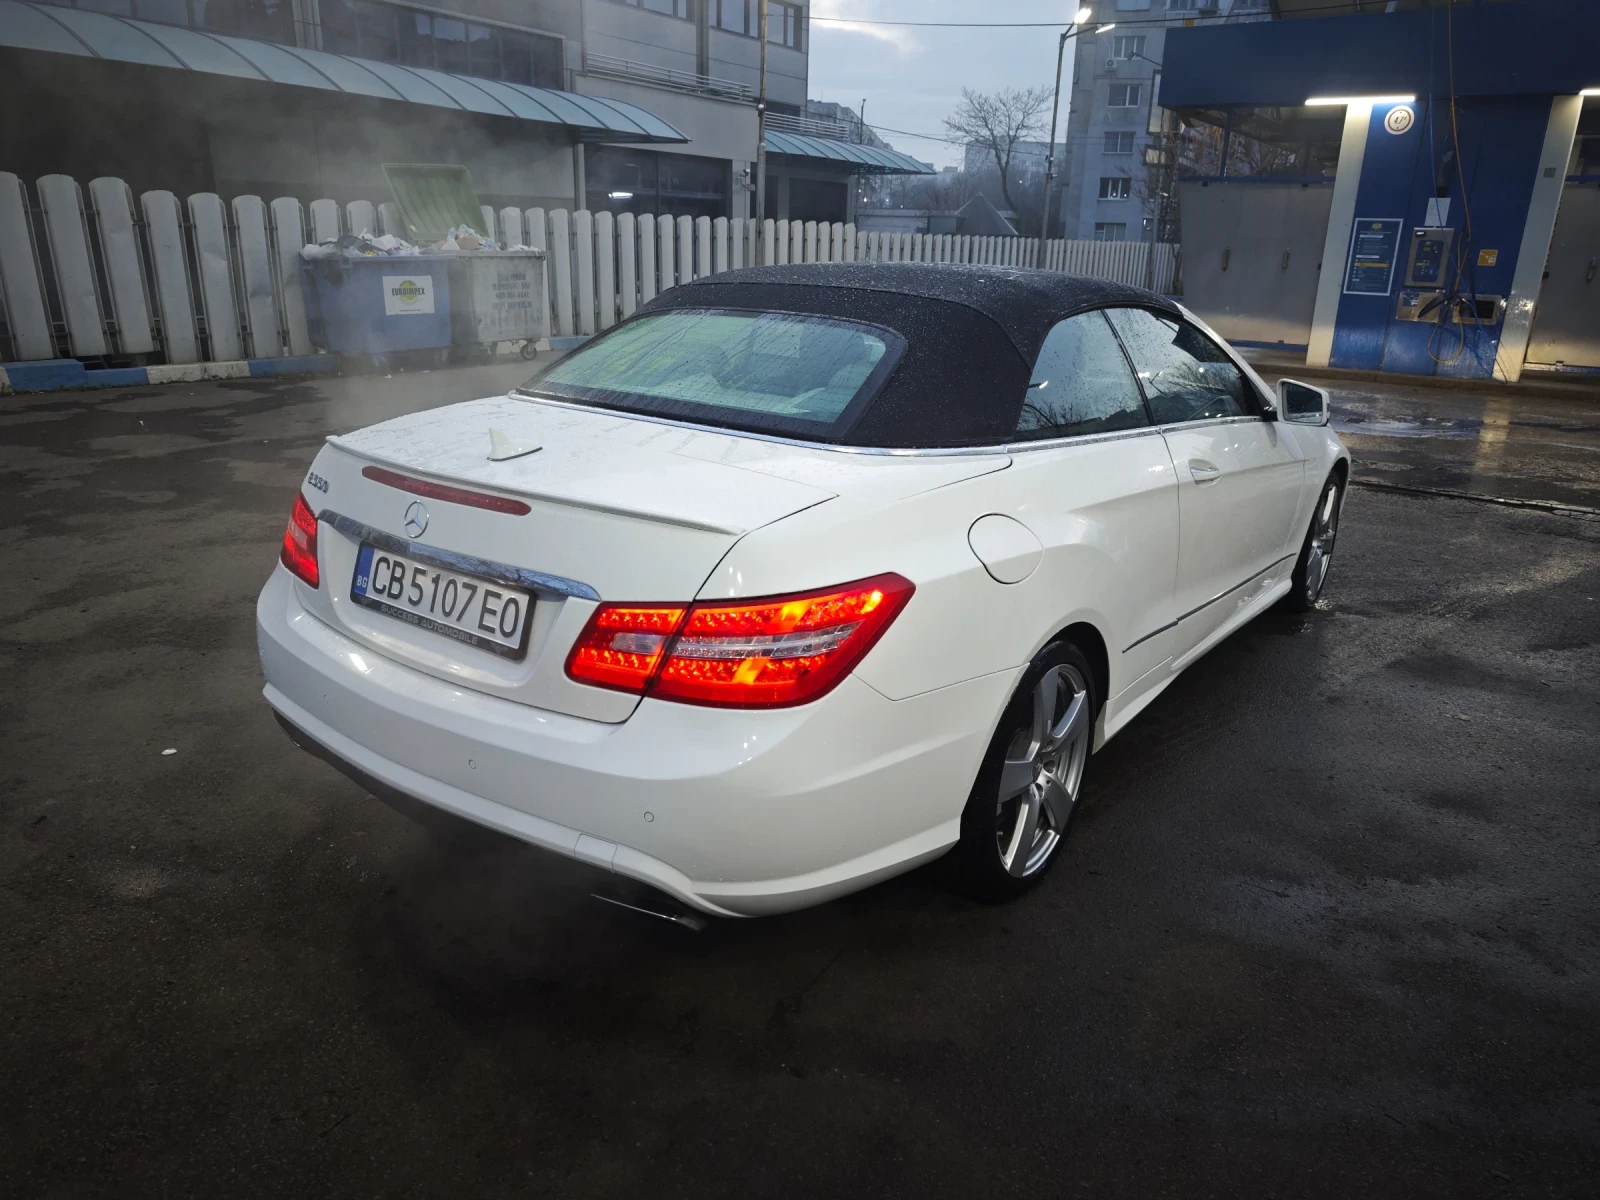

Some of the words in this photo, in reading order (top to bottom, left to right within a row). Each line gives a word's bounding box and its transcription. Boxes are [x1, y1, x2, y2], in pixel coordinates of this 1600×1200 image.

[391, 287, 426, 296] EUROIMPEX
[356, 575, 369, 588] BG
[408, 566, 478, 622] 5107
[380, 604, 419, 624] SUCCESS
[420, 619, 479, 645] AUTOMOBILE
